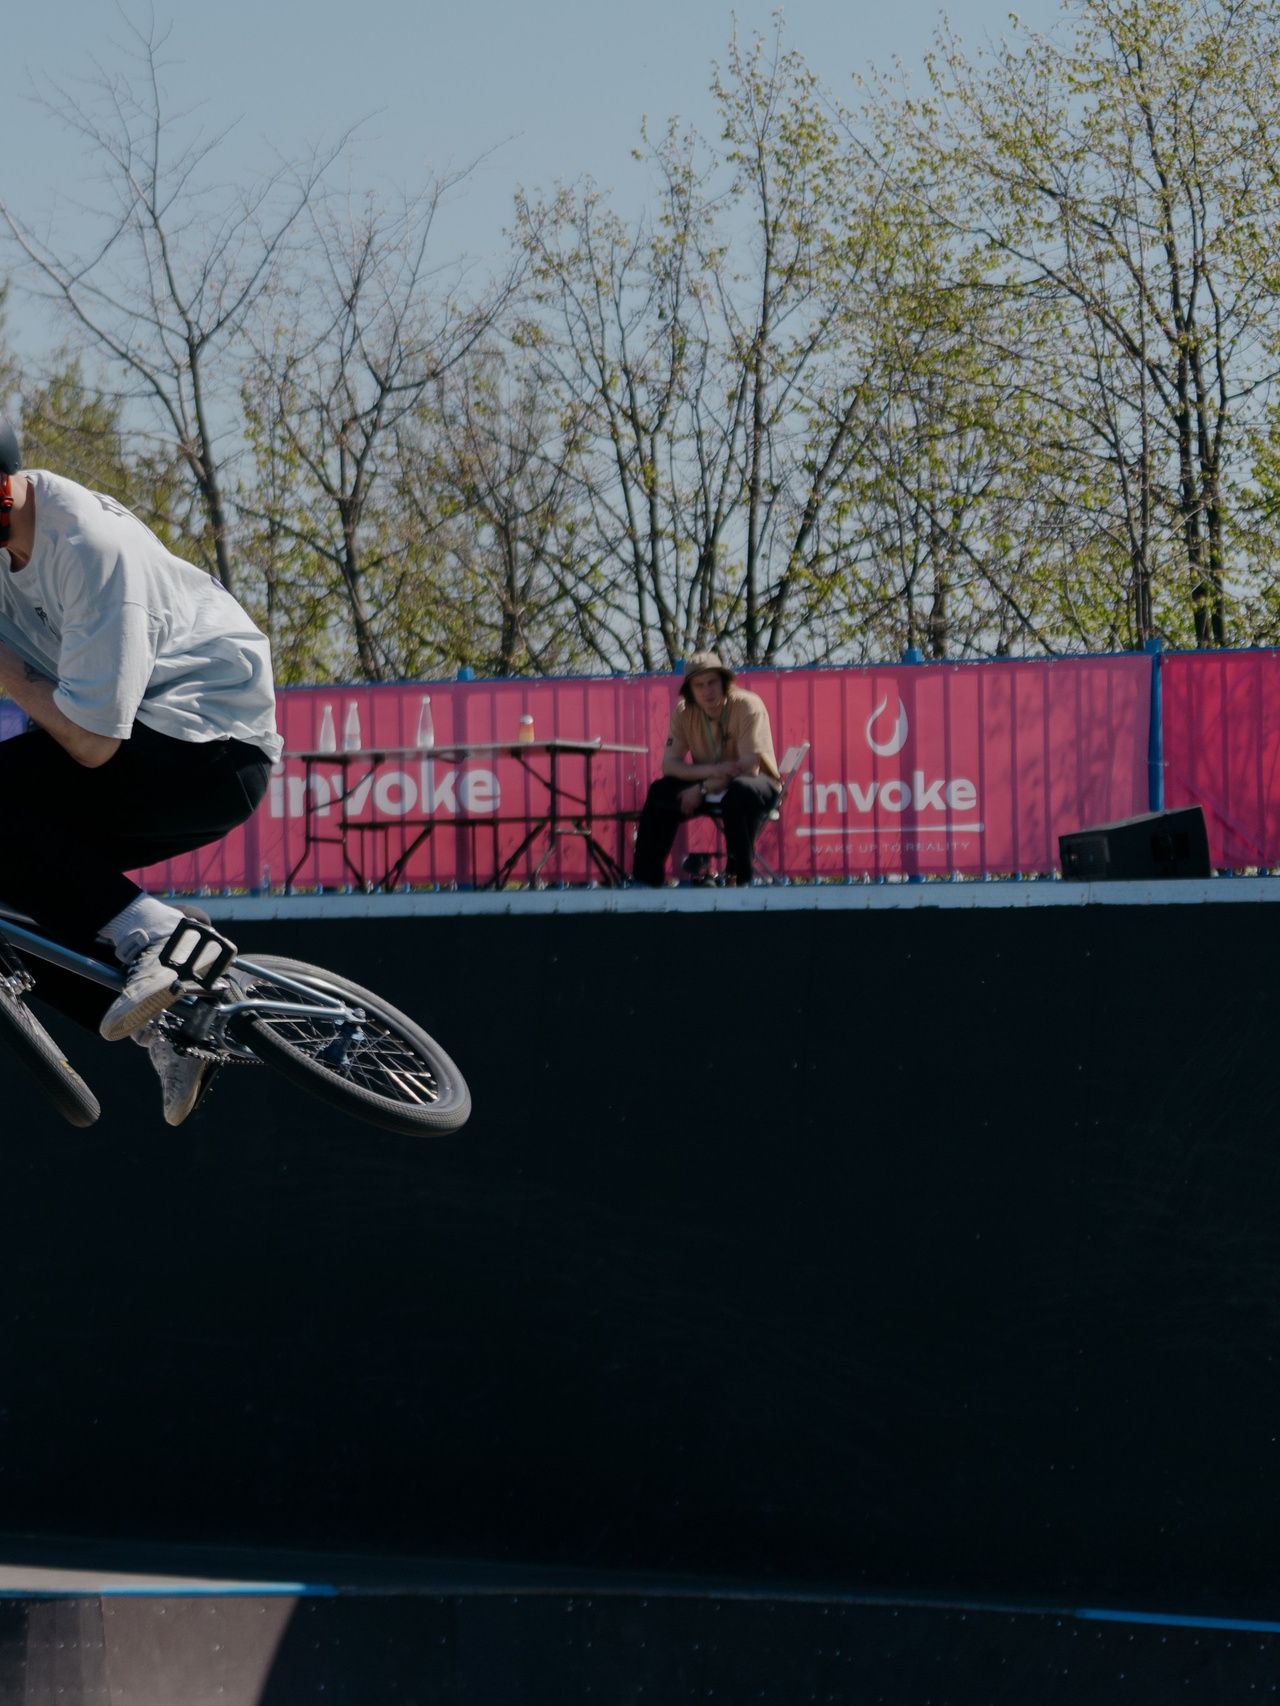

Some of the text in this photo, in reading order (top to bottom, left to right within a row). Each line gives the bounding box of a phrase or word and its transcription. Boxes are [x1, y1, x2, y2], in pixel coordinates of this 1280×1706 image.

[270, 755, 501, 819] invoke
[801, 770, 977, 814] invoke
[812, 841, 970, 854] WAKE UP TO REALITY
